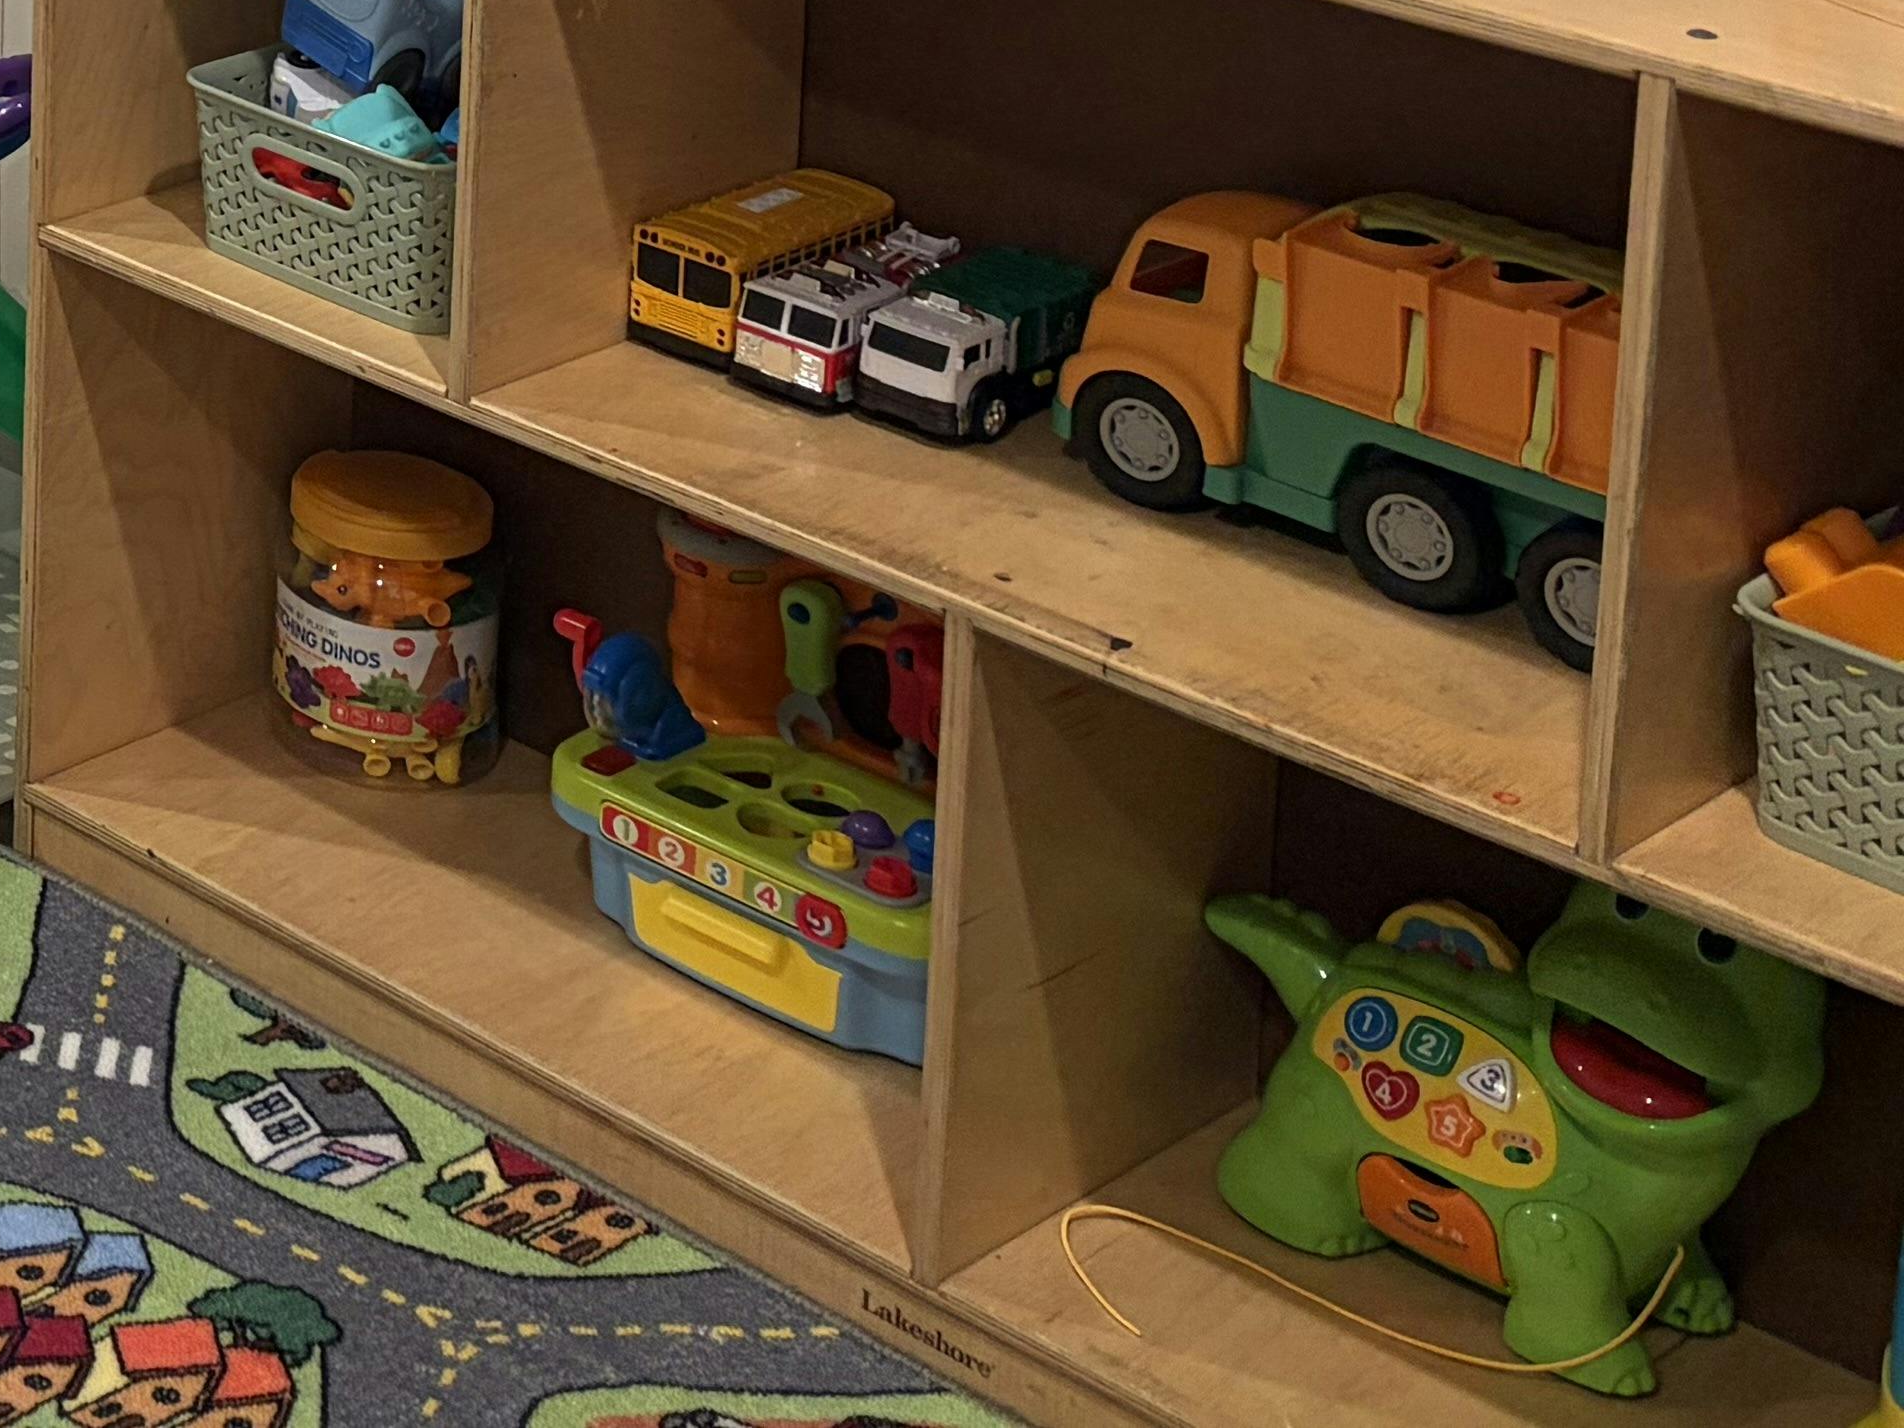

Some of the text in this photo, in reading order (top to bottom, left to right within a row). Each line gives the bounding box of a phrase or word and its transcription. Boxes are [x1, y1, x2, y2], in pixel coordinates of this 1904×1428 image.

[321, 637, 381, 669] DINOS
[663, 842, 680, 861] 2
[709, 862, 727, 886] 3
[756, 886, 778, 911] 4
[1362, 1011, 1373, 1032] 1
[1417, 1033, 1438, 1056] 2
[1481, 1068, 1500, 1092] 3
[1375, 1082, 1392, 1105] 4
[1443, 1114, 1458, 1137] 5
[862, 1287, 991, 1379] Lakeshore
